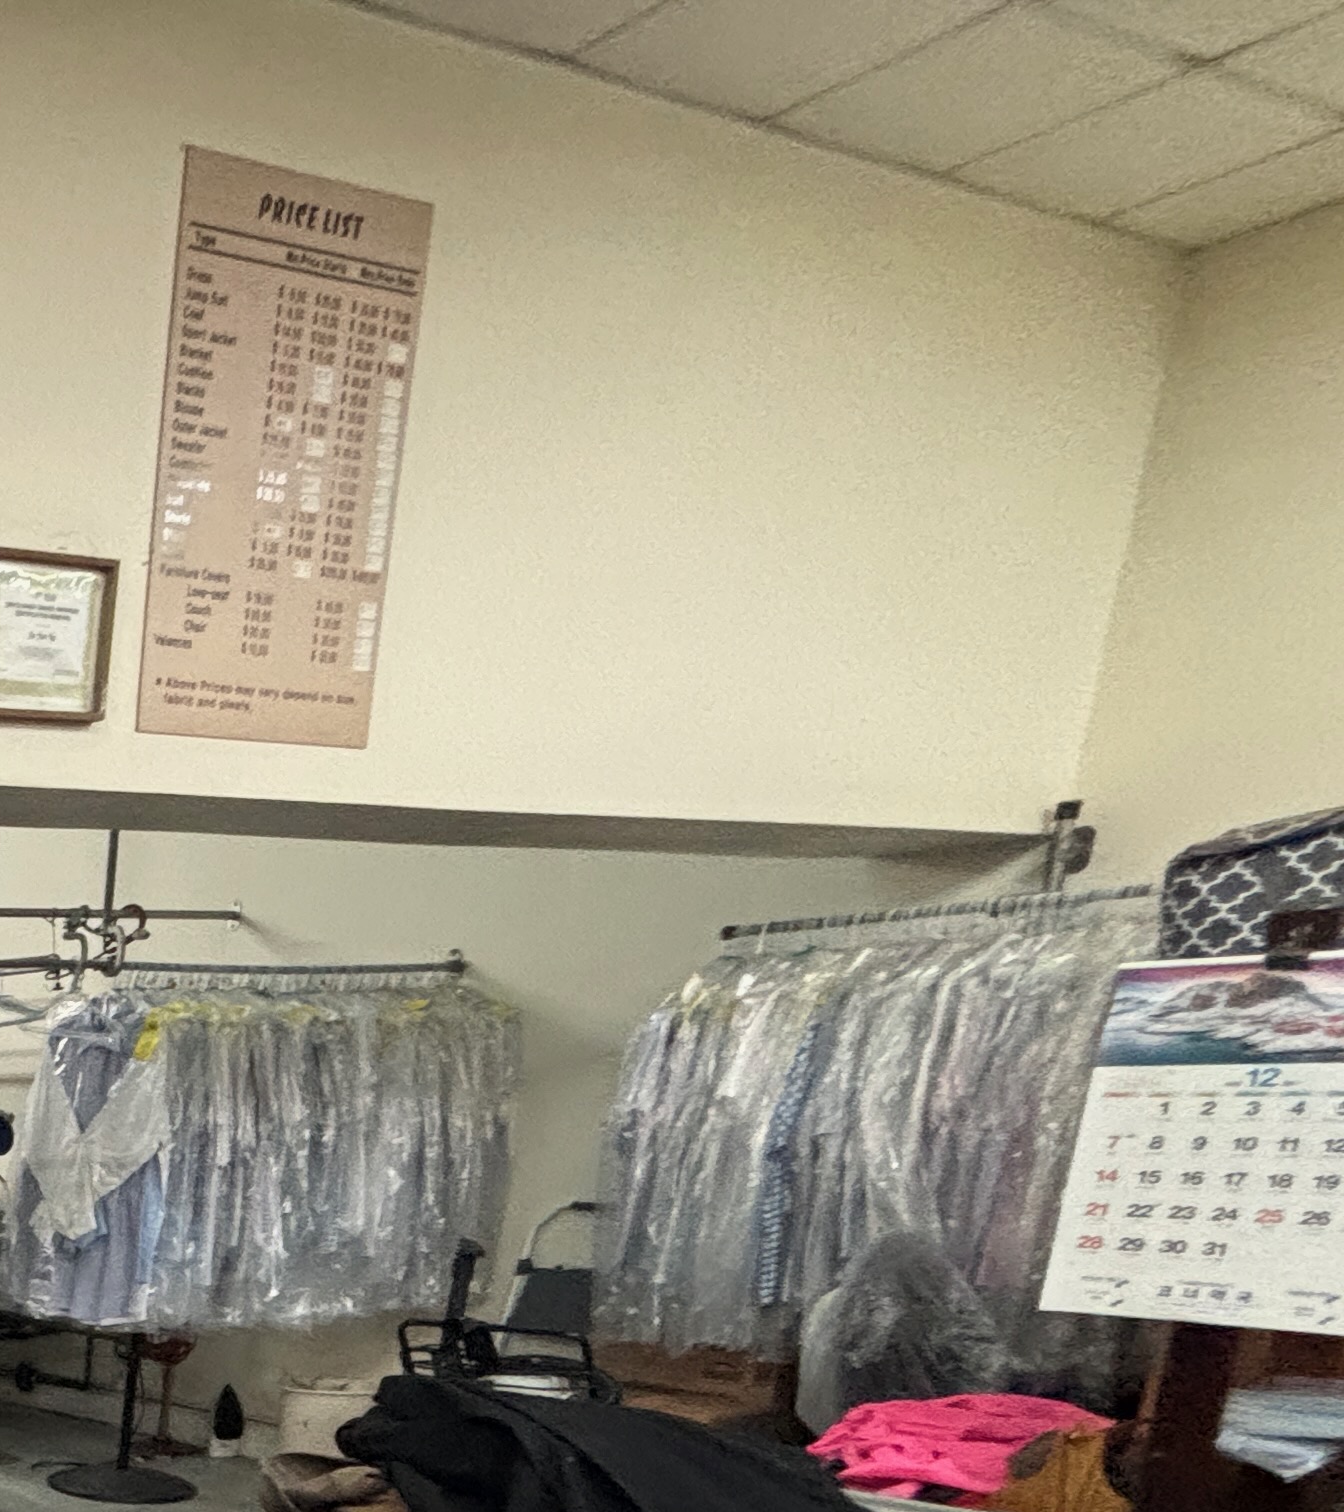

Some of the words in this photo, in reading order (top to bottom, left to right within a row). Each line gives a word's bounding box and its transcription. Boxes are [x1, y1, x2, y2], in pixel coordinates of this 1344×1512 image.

[258, 193, 316, 231] PRICE
[322, 207, 364, 241] LIST
[1246, 1067, 1282, 1088] 12
[1158, 1101, 1172, 1117] 1
[1200, 1101, 1217, 1117] 2
[1244, 1101, 1262, 1117] 3
[1288, 1101, 1307, 1117] 4
[1108, 1135, 1120, 1150] 7
[1149, 1136, 1164, 1151] 8
[1191, 1136, 1208, 1151] 9
[1233, 1136, 1259, 1152] 10
[1278, 1137, 1301, 1153] 11
[1324, 1137, 1344, 1154] 12
[1095, 1169, 1119, 1184] 14
[1138, 1169, 1163, 1185] 15
[1180, 1170, 1205, 1186] 16
[1223, 1171, 1249, 1187] 17
[1267, 1172, 1294, 1189] 18
[1313, 1174, 1341, 1190] 19
[1085, 1202, 1109, 1217] 21
[1126, 1203, 1154, 1219] 22
[1168, 1204, 1197, 1220] 23
[1210, 1207, 1238, 1222] 24
[1253, 1208, 1285, 1225] 25
[1298, 1210, 1332, 1226] 26
[1076, 1235, 1105, 1250] 28
[1117, 1236, 1145, 1252] 29
[1158, 1239, 1189, 1254] 30
[1200, 1240, 1227, 1258] 31
